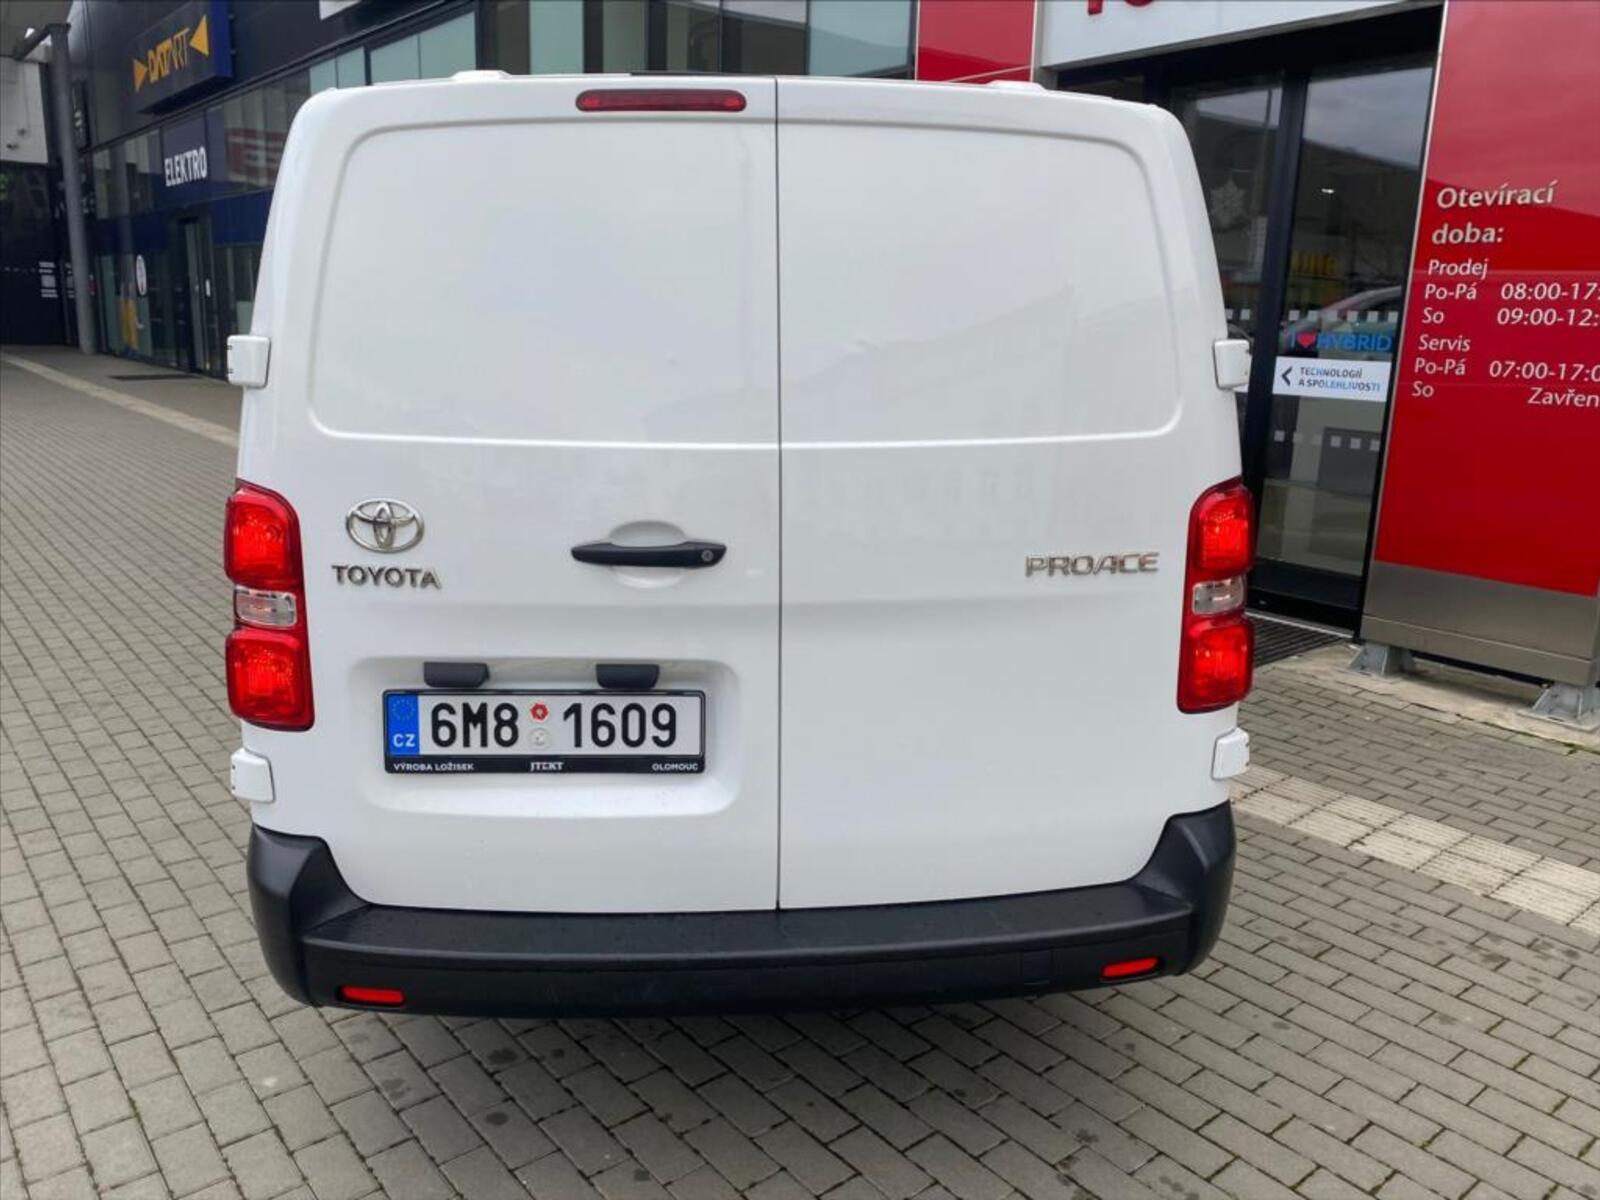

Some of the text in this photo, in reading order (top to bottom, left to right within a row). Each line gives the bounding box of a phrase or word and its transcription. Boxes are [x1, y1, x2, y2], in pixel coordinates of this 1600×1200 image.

[164, 146, 208, 187] ELEKTRO
[1437, 180, 1559, 208] Otevírací
[1431, 221, 1505, 244] doba:
[1428, 258, 1489, 280] Prodej
[1425, 282, 1478, 300] Po-Pá
[1422, 307, 1600, 327] So 09:00-12:
[1317, 330, 1393, 352] HYBRID
[1418, 335, 1471, 351] Servis
[1414, 357, 1466, 376] Po-Pá
[1298, 378, 1381, 392] A SPOLEHLIVOSTI
[1412, 381, 1600, 407] So Zavřen
[1025, 551, 1159, 577] PROACE
[331, 565, 442, 590] TOYOTA
[431, 702, 677, 748] 6M8 1609
[393, 734, 416, 748] CZ
[394, 762, 433, 771] VÝROBA
[652, 763, 699, 771] OLOMOUC
